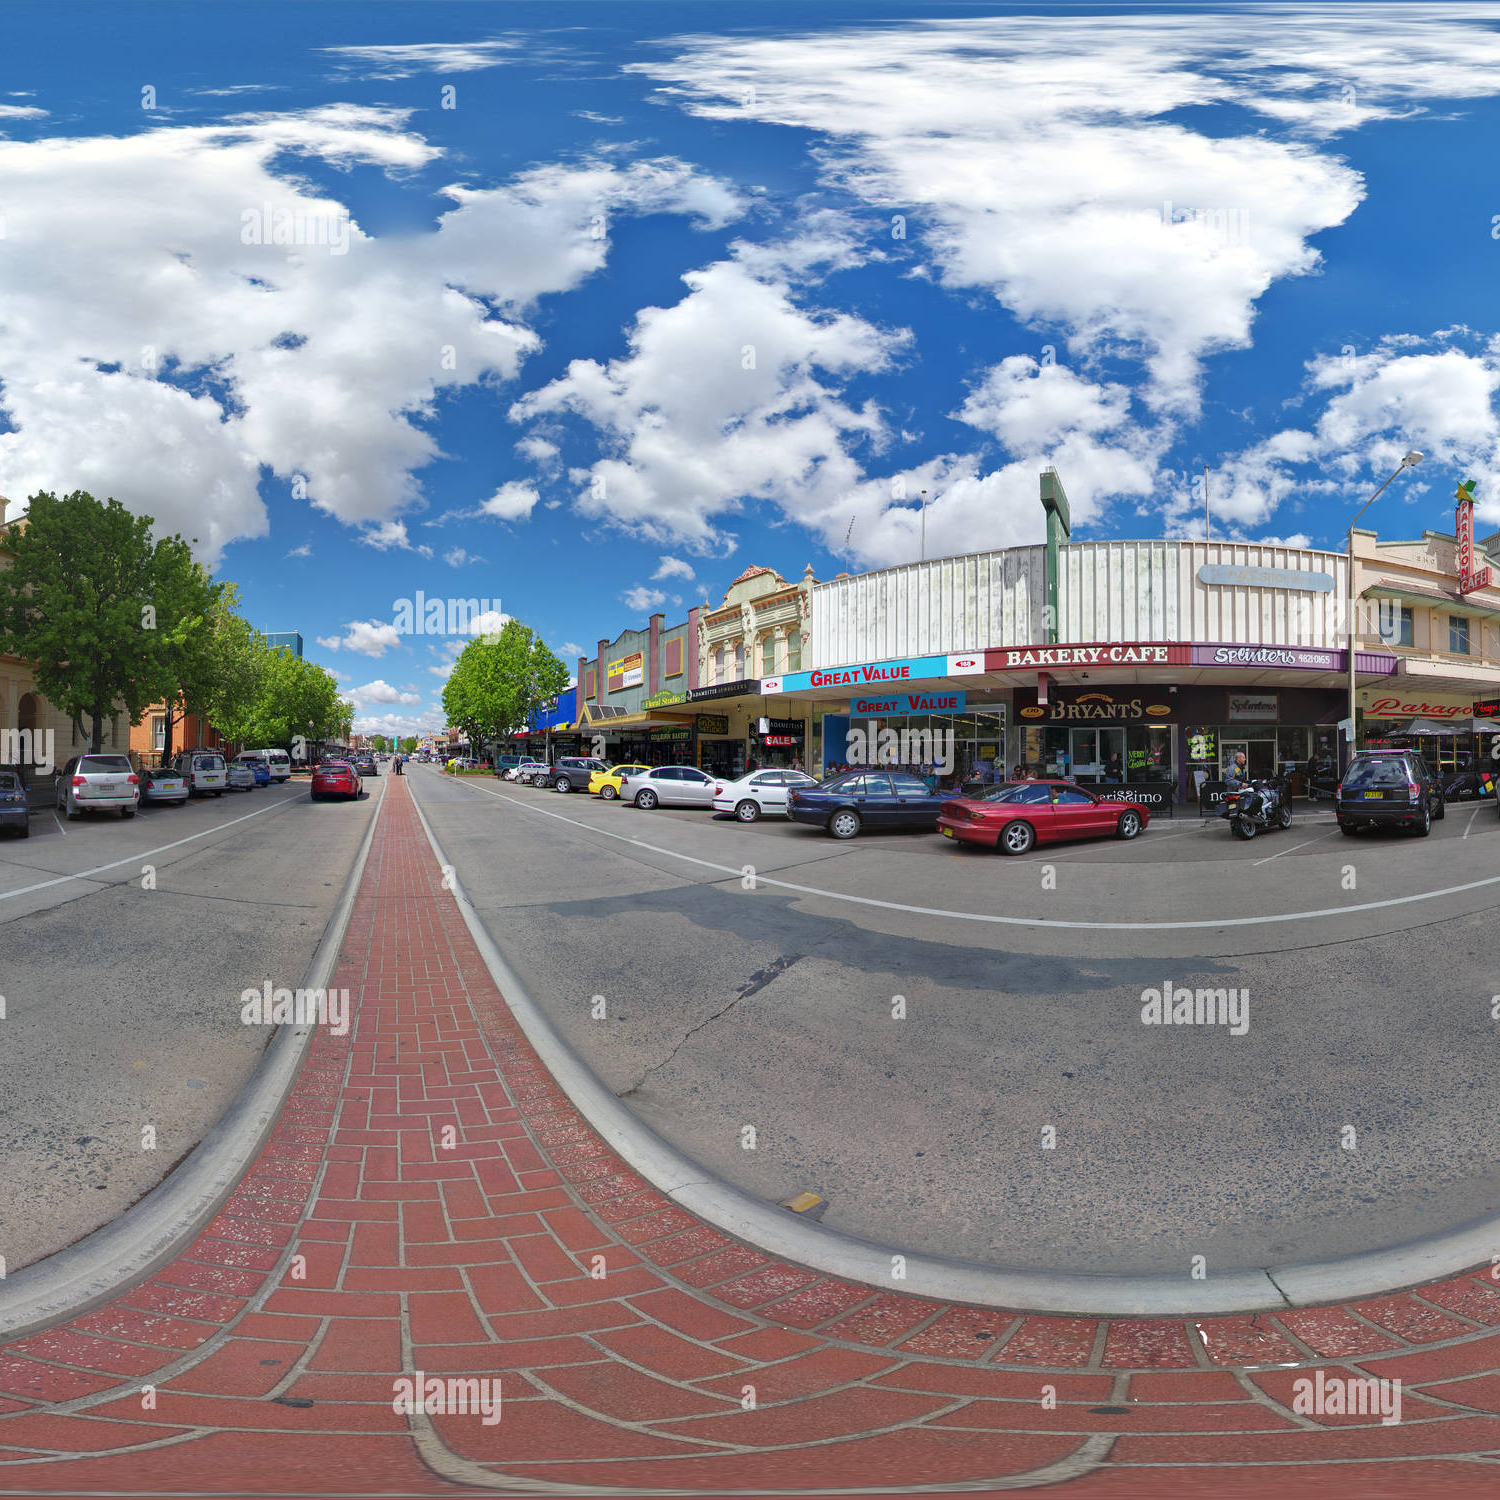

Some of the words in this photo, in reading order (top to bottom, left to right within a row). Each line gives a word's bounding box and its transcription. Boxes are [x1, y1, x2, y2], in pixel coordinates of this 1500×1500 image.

[1461, 500, 1469, 580] PARAGON
[1460, 570, 1487, 592] CAFE
[1213, 648, 1296, 665] Splinters
[810, 670, 861, 687] GREAT
[862, 665, 910, 682] VALUE
[856, 700, 898, 714] GREAT
[908, 695, 958, 711] VALUE
[1050, 699, 1142, 720] BRYANTS
[1364, 698, 1473, 718] Parago
[766, 736, 790, 745] SALE
